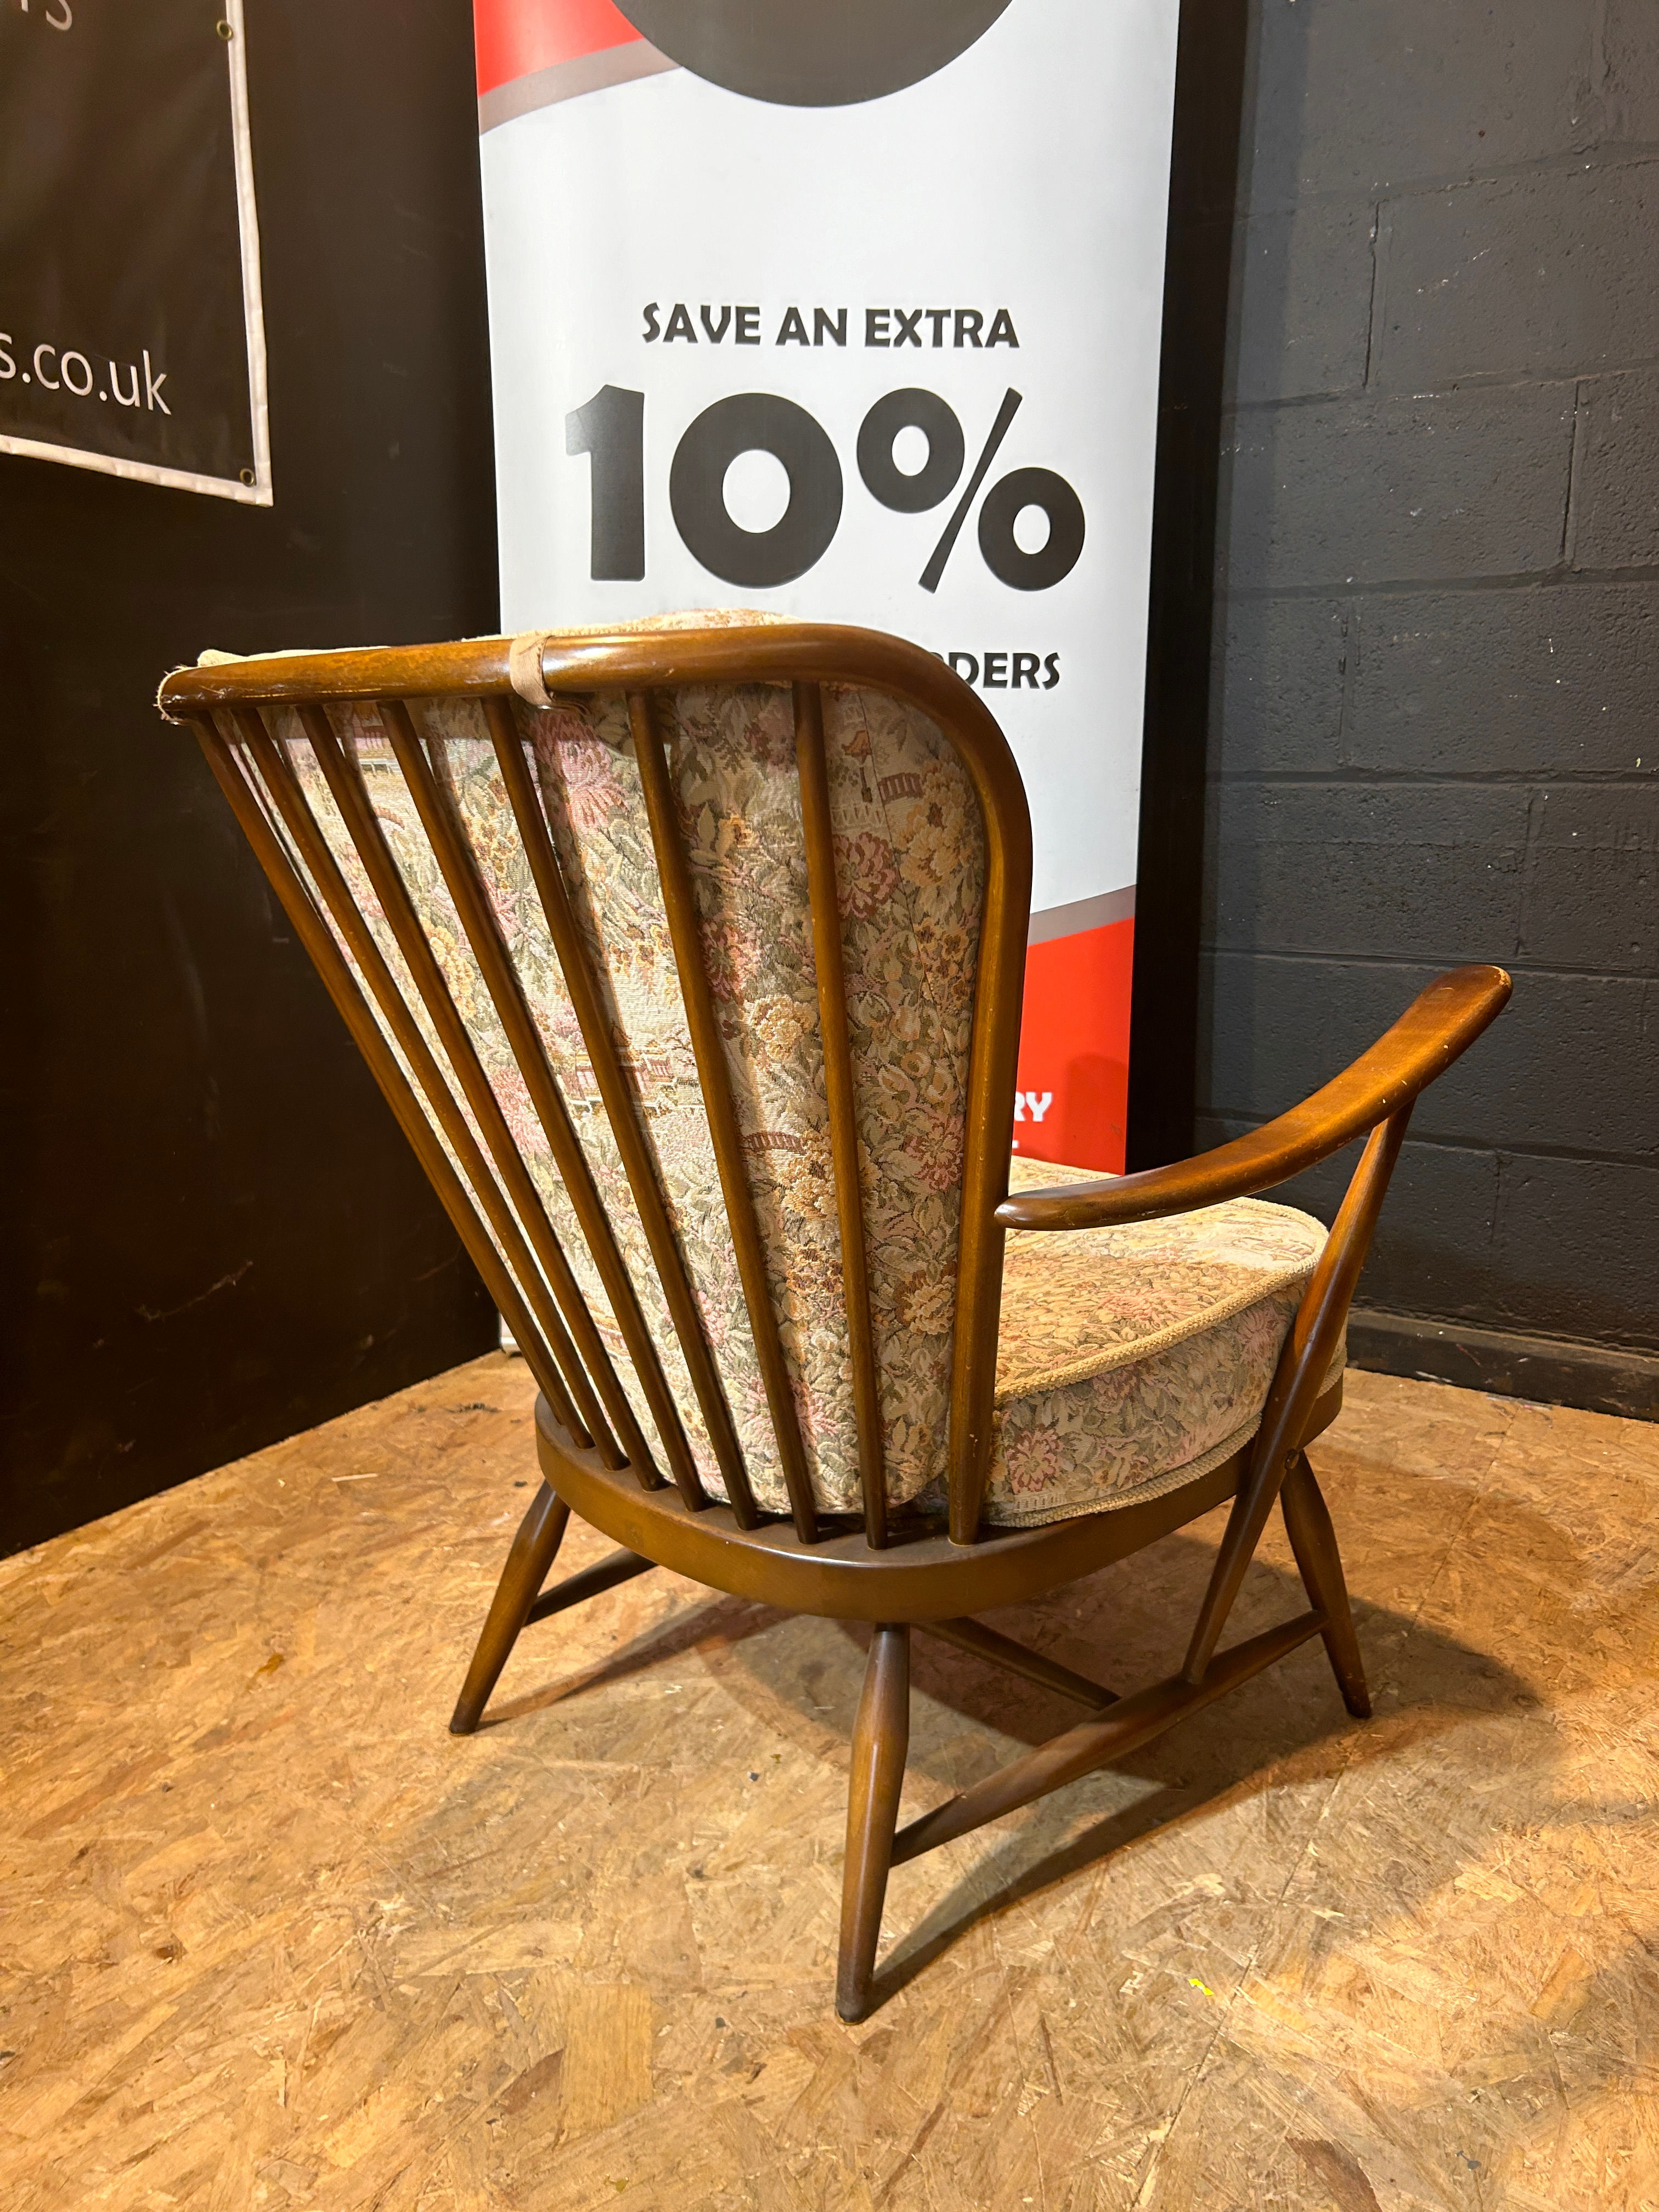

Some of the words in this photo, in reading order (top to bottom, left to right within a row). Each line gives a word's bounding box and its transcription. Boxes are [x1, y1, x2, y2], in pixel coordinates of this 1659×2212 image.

[642, 302, 761, 345] SAVE
[776, 307, 848, 347] AN
[865, 309, 1019, 348] EXTRA
[566, 384, 1086, 594] 10%
